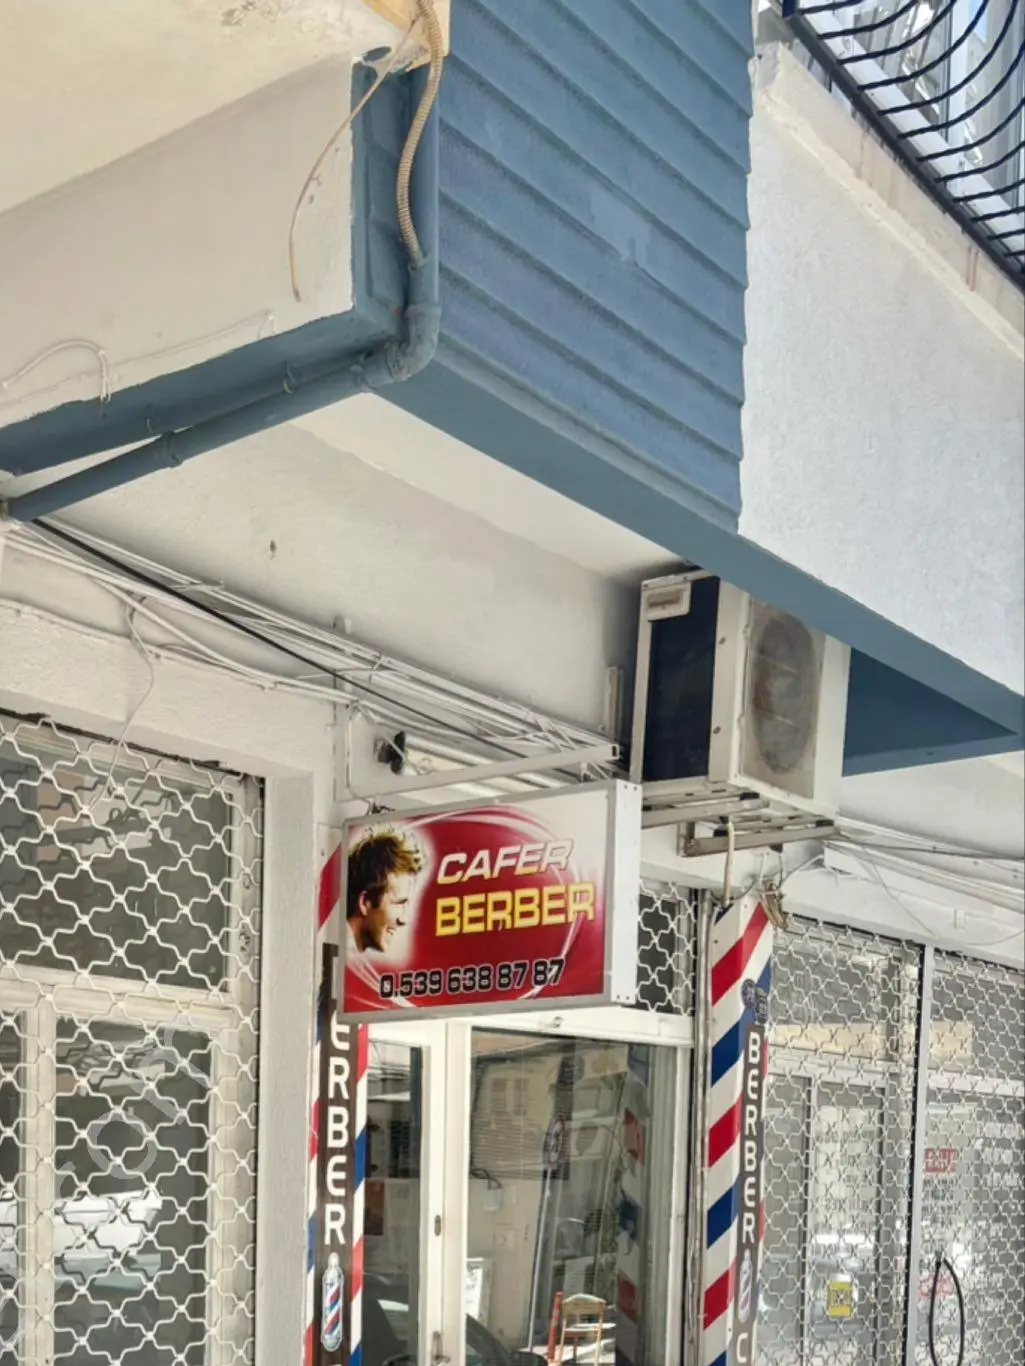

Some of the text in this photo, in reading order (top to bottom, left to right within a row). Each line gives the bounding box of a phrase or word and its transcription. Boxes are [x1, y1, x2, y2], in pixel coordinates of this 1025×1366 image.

[436, 838, 574, 885] CAFER
[434, 880, 596, 937] BERBER
[379, 956, 566, 999] 0.539 638 87 87
[323, 956, 352, 1246] ERBER
[741, 1031, 761, 1244] BERBER
